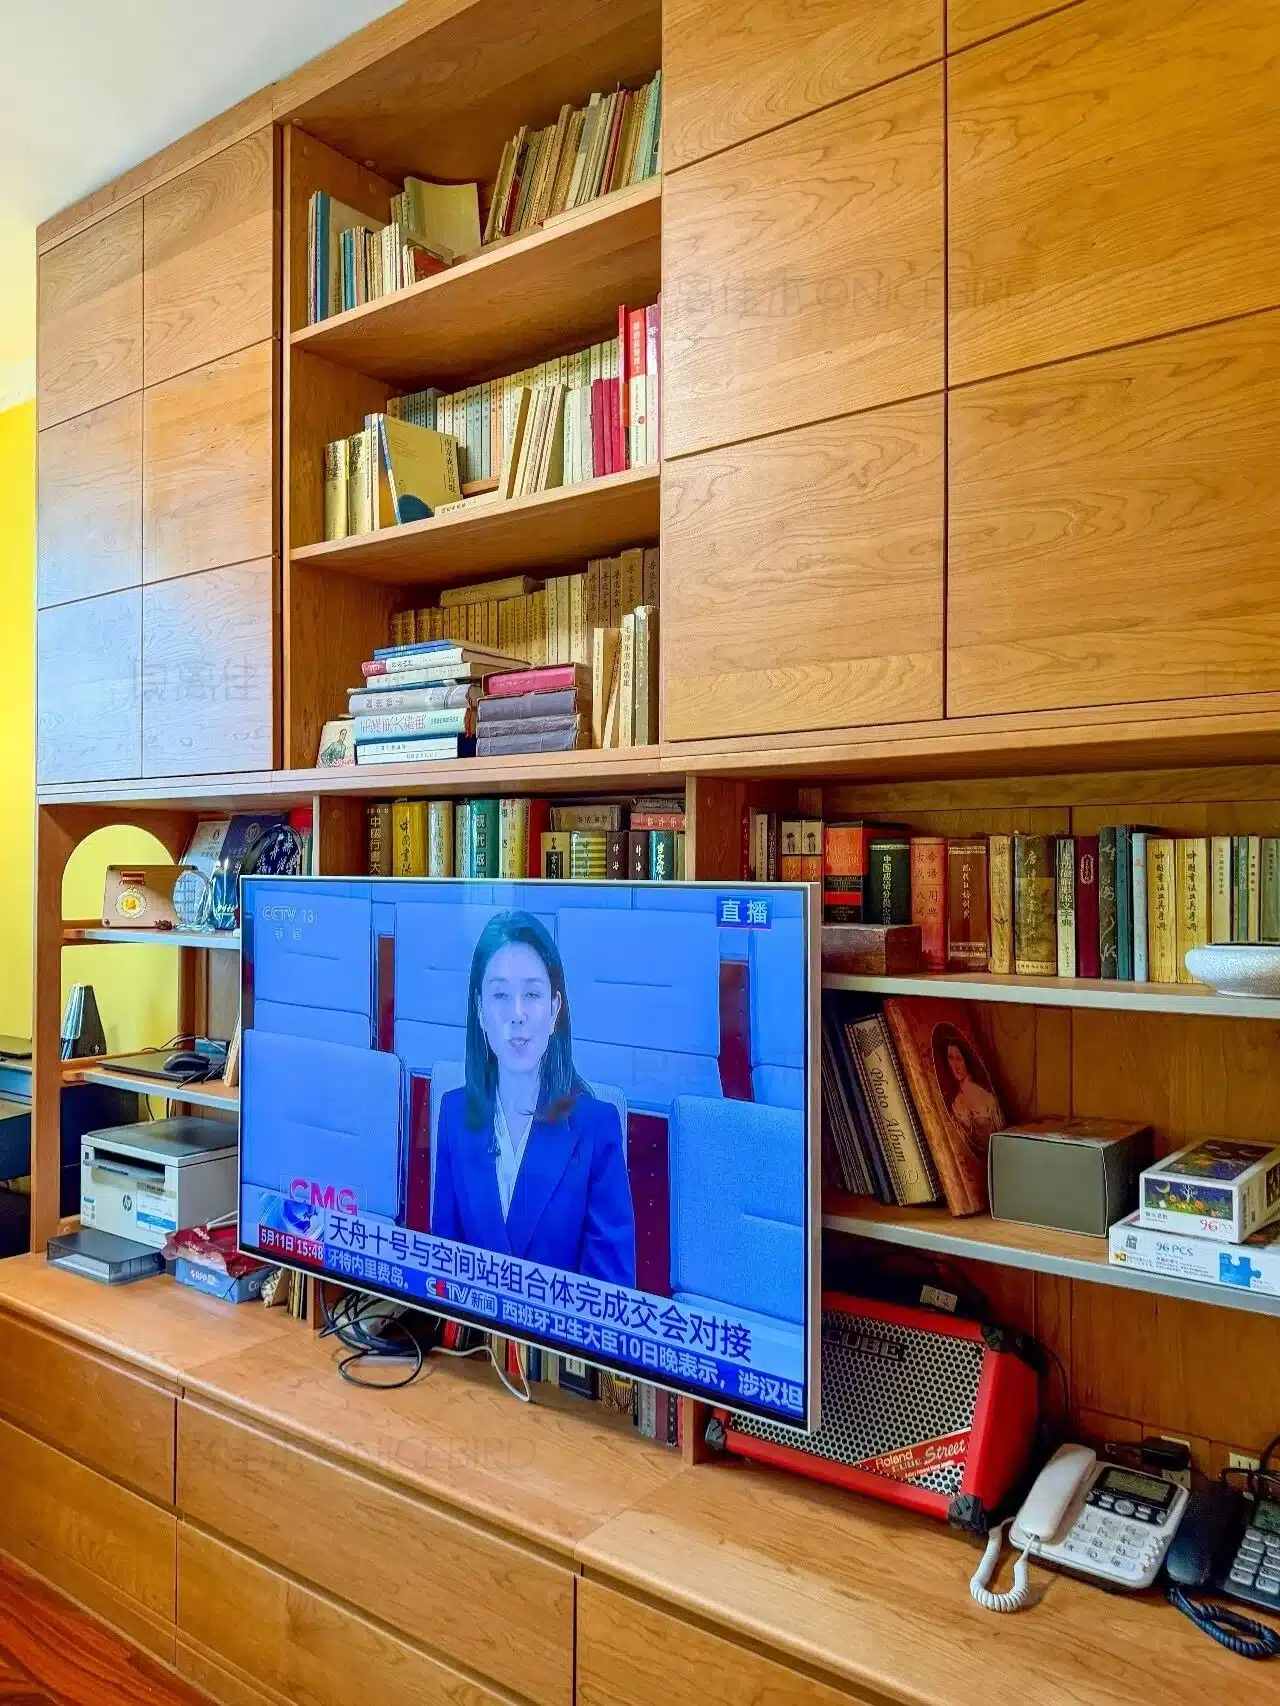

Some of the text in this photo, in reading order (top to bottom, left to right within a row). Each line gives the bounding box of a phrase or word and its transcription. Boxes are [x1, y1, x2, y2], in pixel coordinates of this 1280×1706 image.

[370, 816, 381, 878] 中國行書大
[302, 909, 314, 924] 13
[720, 898, 768, 924] 直播
[871, 1066, 907, 1163] Photo Album
[289, 1178, 358, 1216] CMG
[1199, 1218, 1218, 1232] 96
[261, 1228, 324, 1261] 5月11日 15:48
[1156, 1241, 1194, 1257] 96 PCS
[329, 1214, 752, 1363] 天舟十号与空间站组合体完成交会对接
[470, 1289, 496, 1314] 新闻
[875, 1449, 914, 1470] Roland
[923, 1438, 966, 1465] Street
